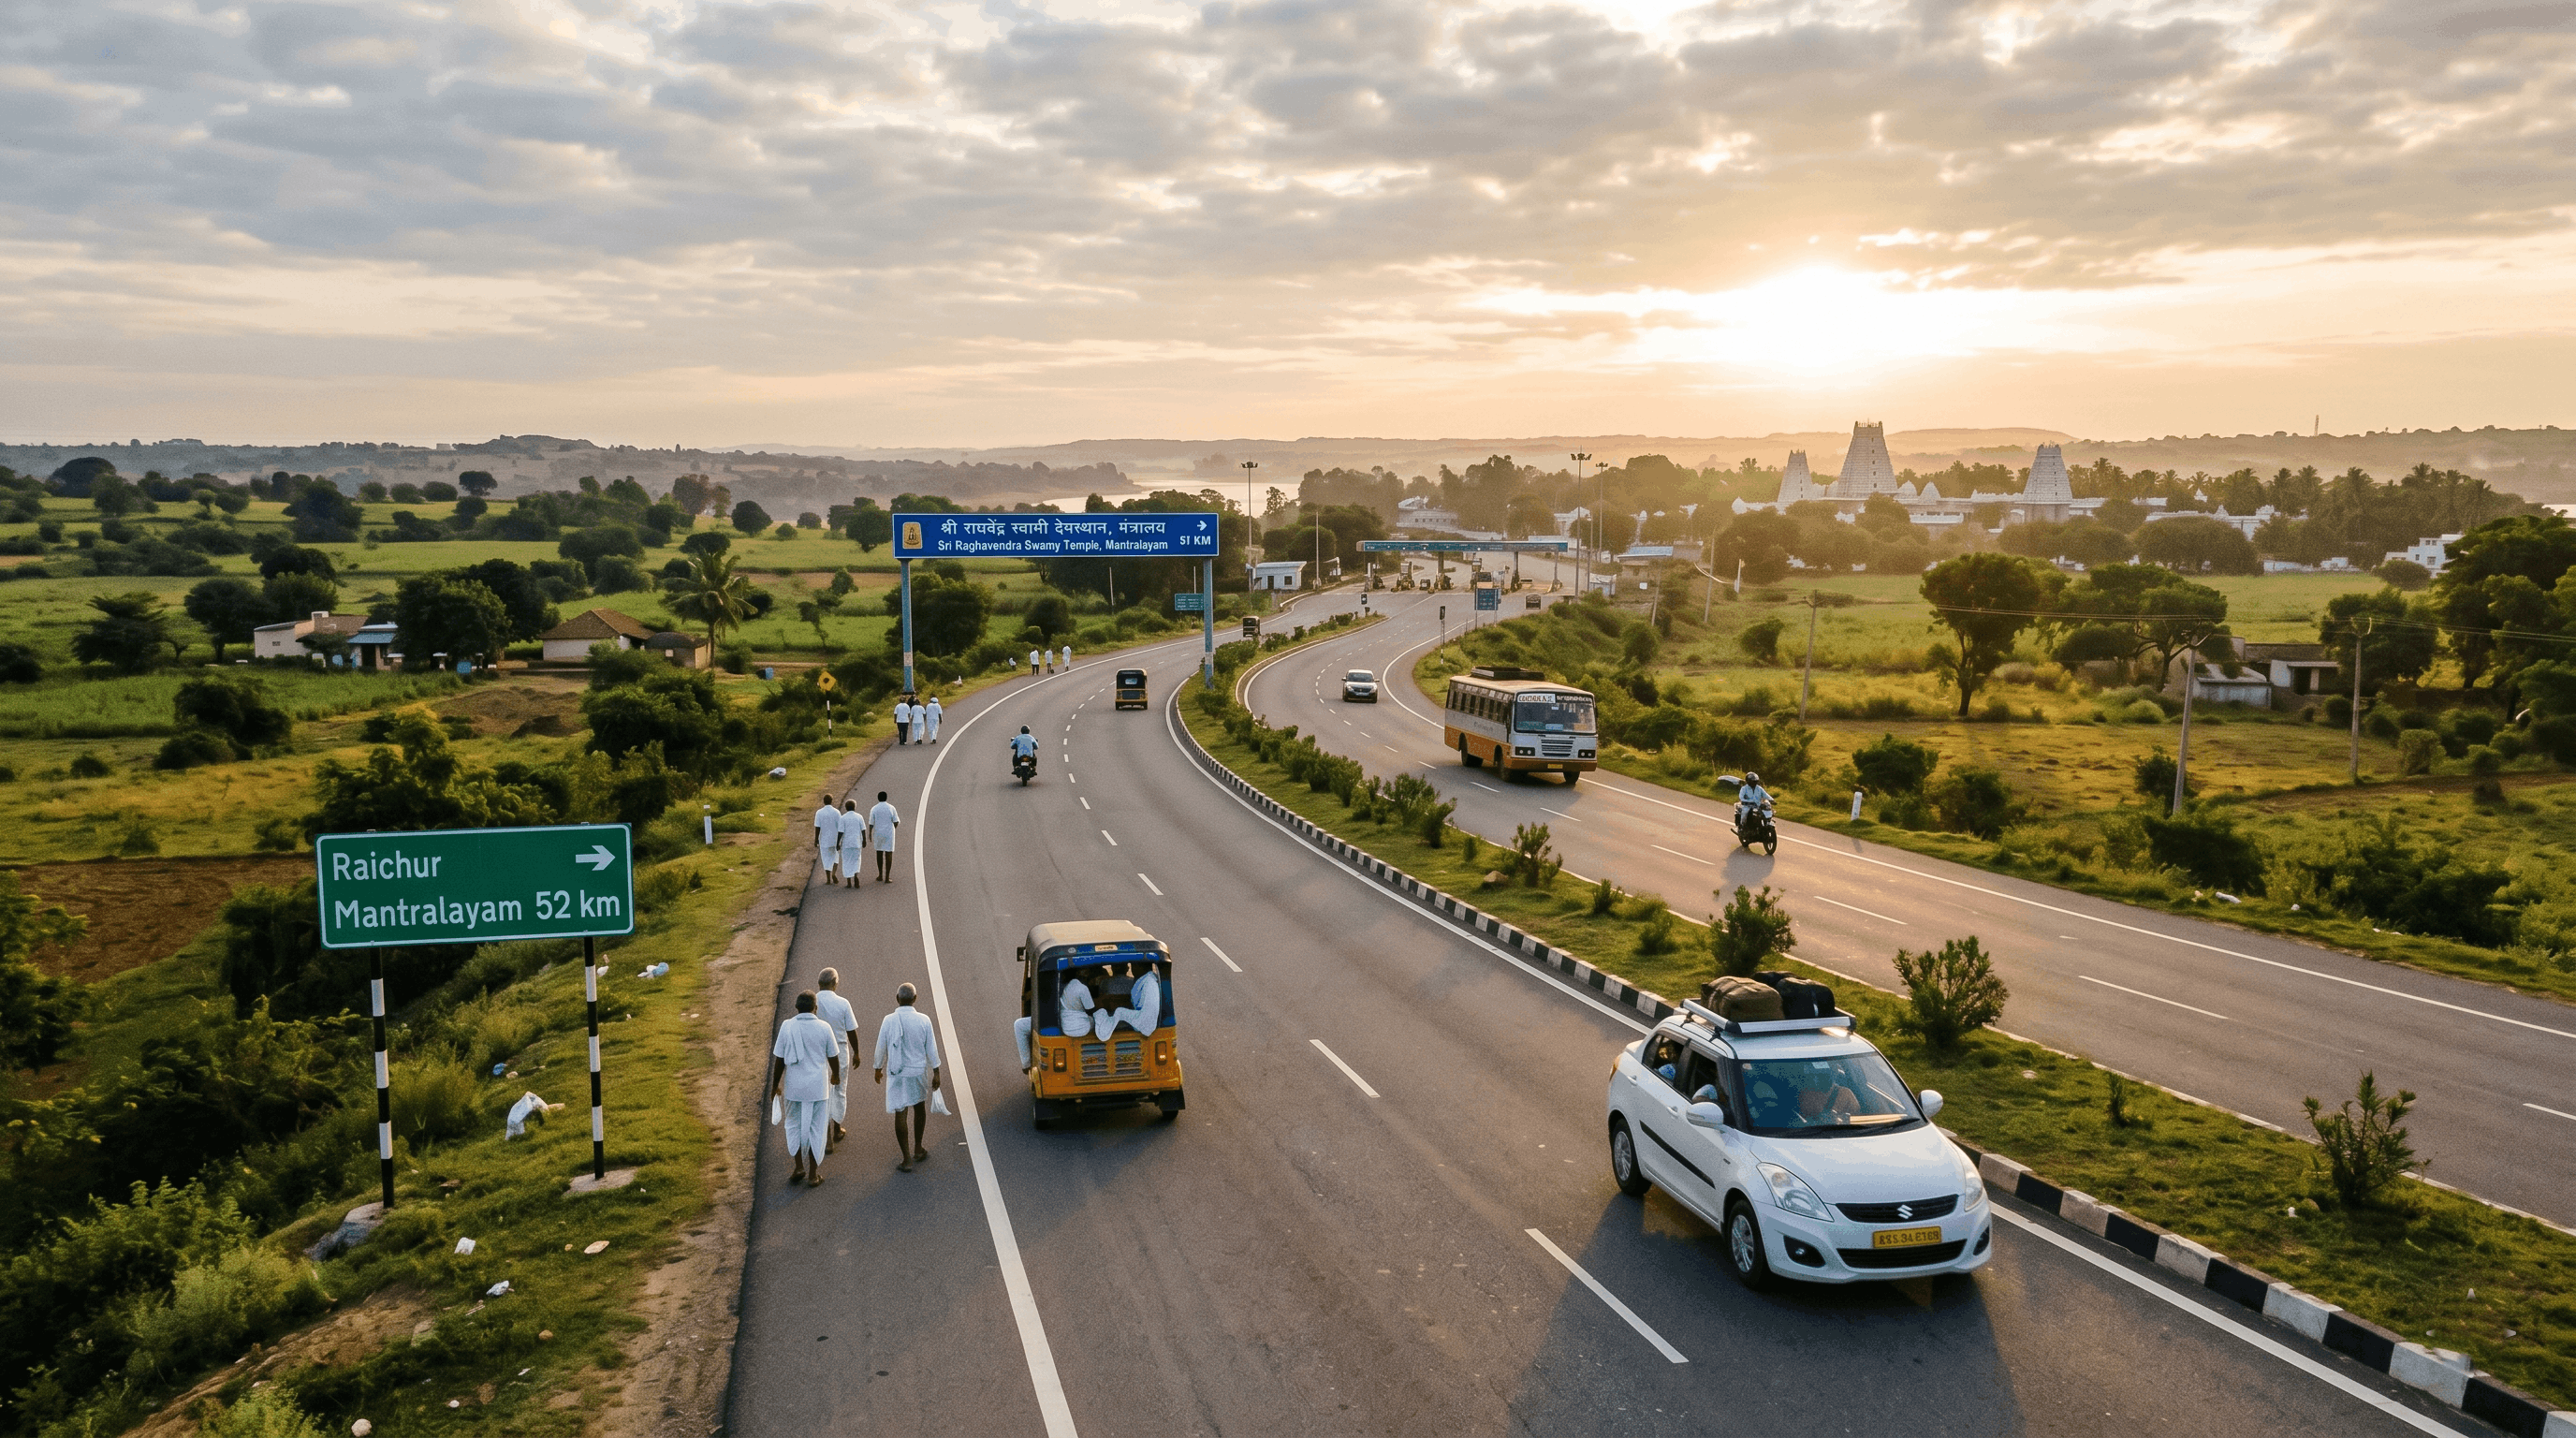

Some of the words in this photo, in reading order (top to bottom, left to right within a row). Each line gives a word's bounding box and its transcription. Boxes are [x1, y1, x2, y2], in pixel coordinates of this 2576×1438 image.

[941, 519, 958, 535] श्री
[1010, 519, 1049, 535] स्वामी
[1118, 519, 1166, 534] मंत्रालय
[938, 539, 952, 550] Sri
[955, 539, 1022, 553] Raghavendra
[1024, 539, 1061, 553] Swamy
[1105, 539, 1168, 553] Mantralayam
[1193, 536, 1211, 546] KM
[332, 850, 442, 881] Raichur
[335, 895, 522, 930] Mantralayam
[535, 890, 572, 920] 52
[579, 889, 621, 918] km
